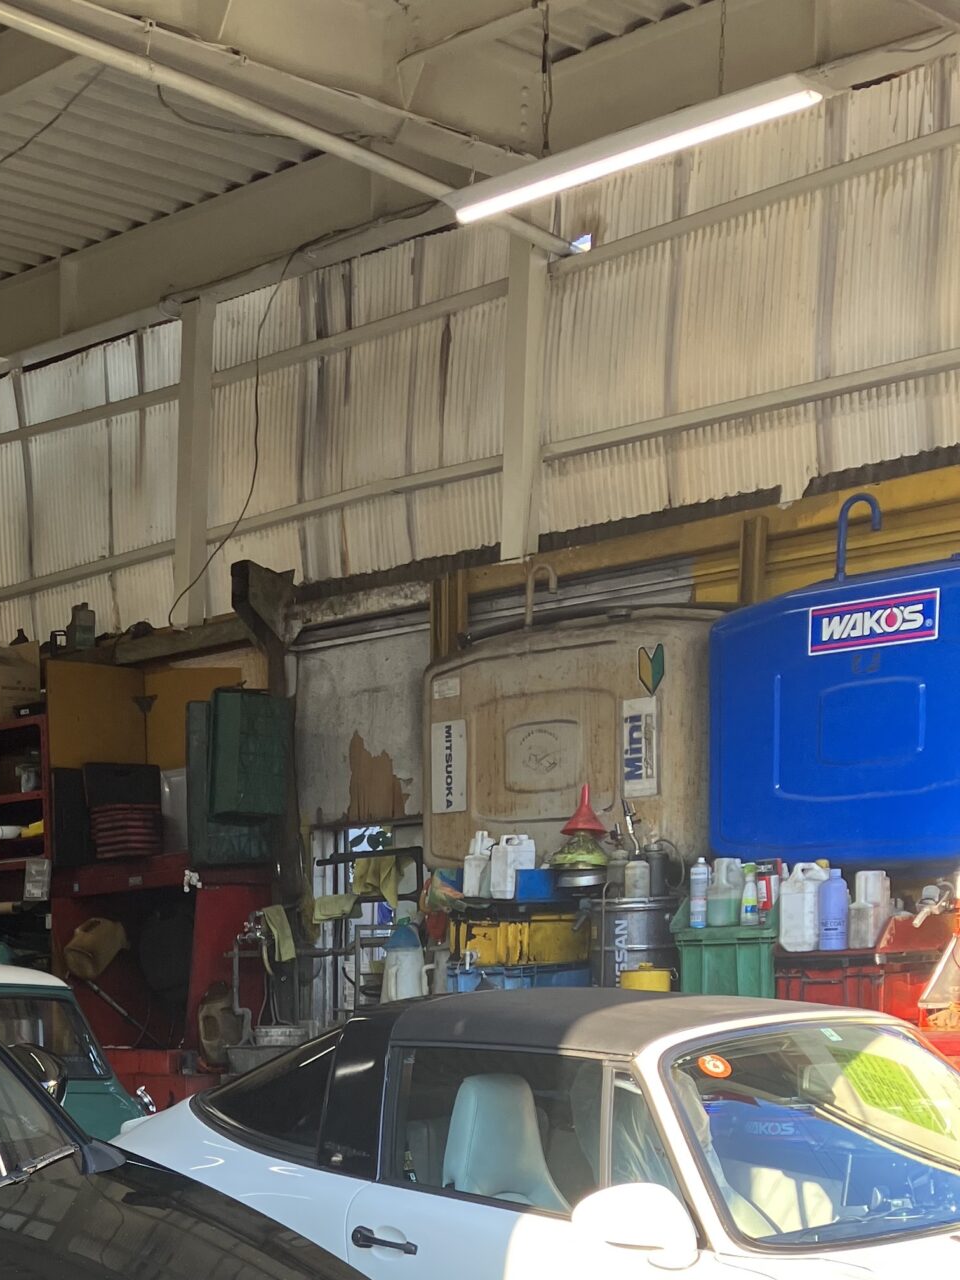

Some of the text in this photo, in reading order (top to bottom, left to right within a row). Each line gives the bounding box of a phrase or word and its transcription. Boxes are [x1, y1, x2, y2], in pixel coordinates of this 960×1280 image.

[445, 725, 453, 809] MITSUOKA
[624, 714, 643, 780] Mini
[615, 920, 628, 988] SSAN
